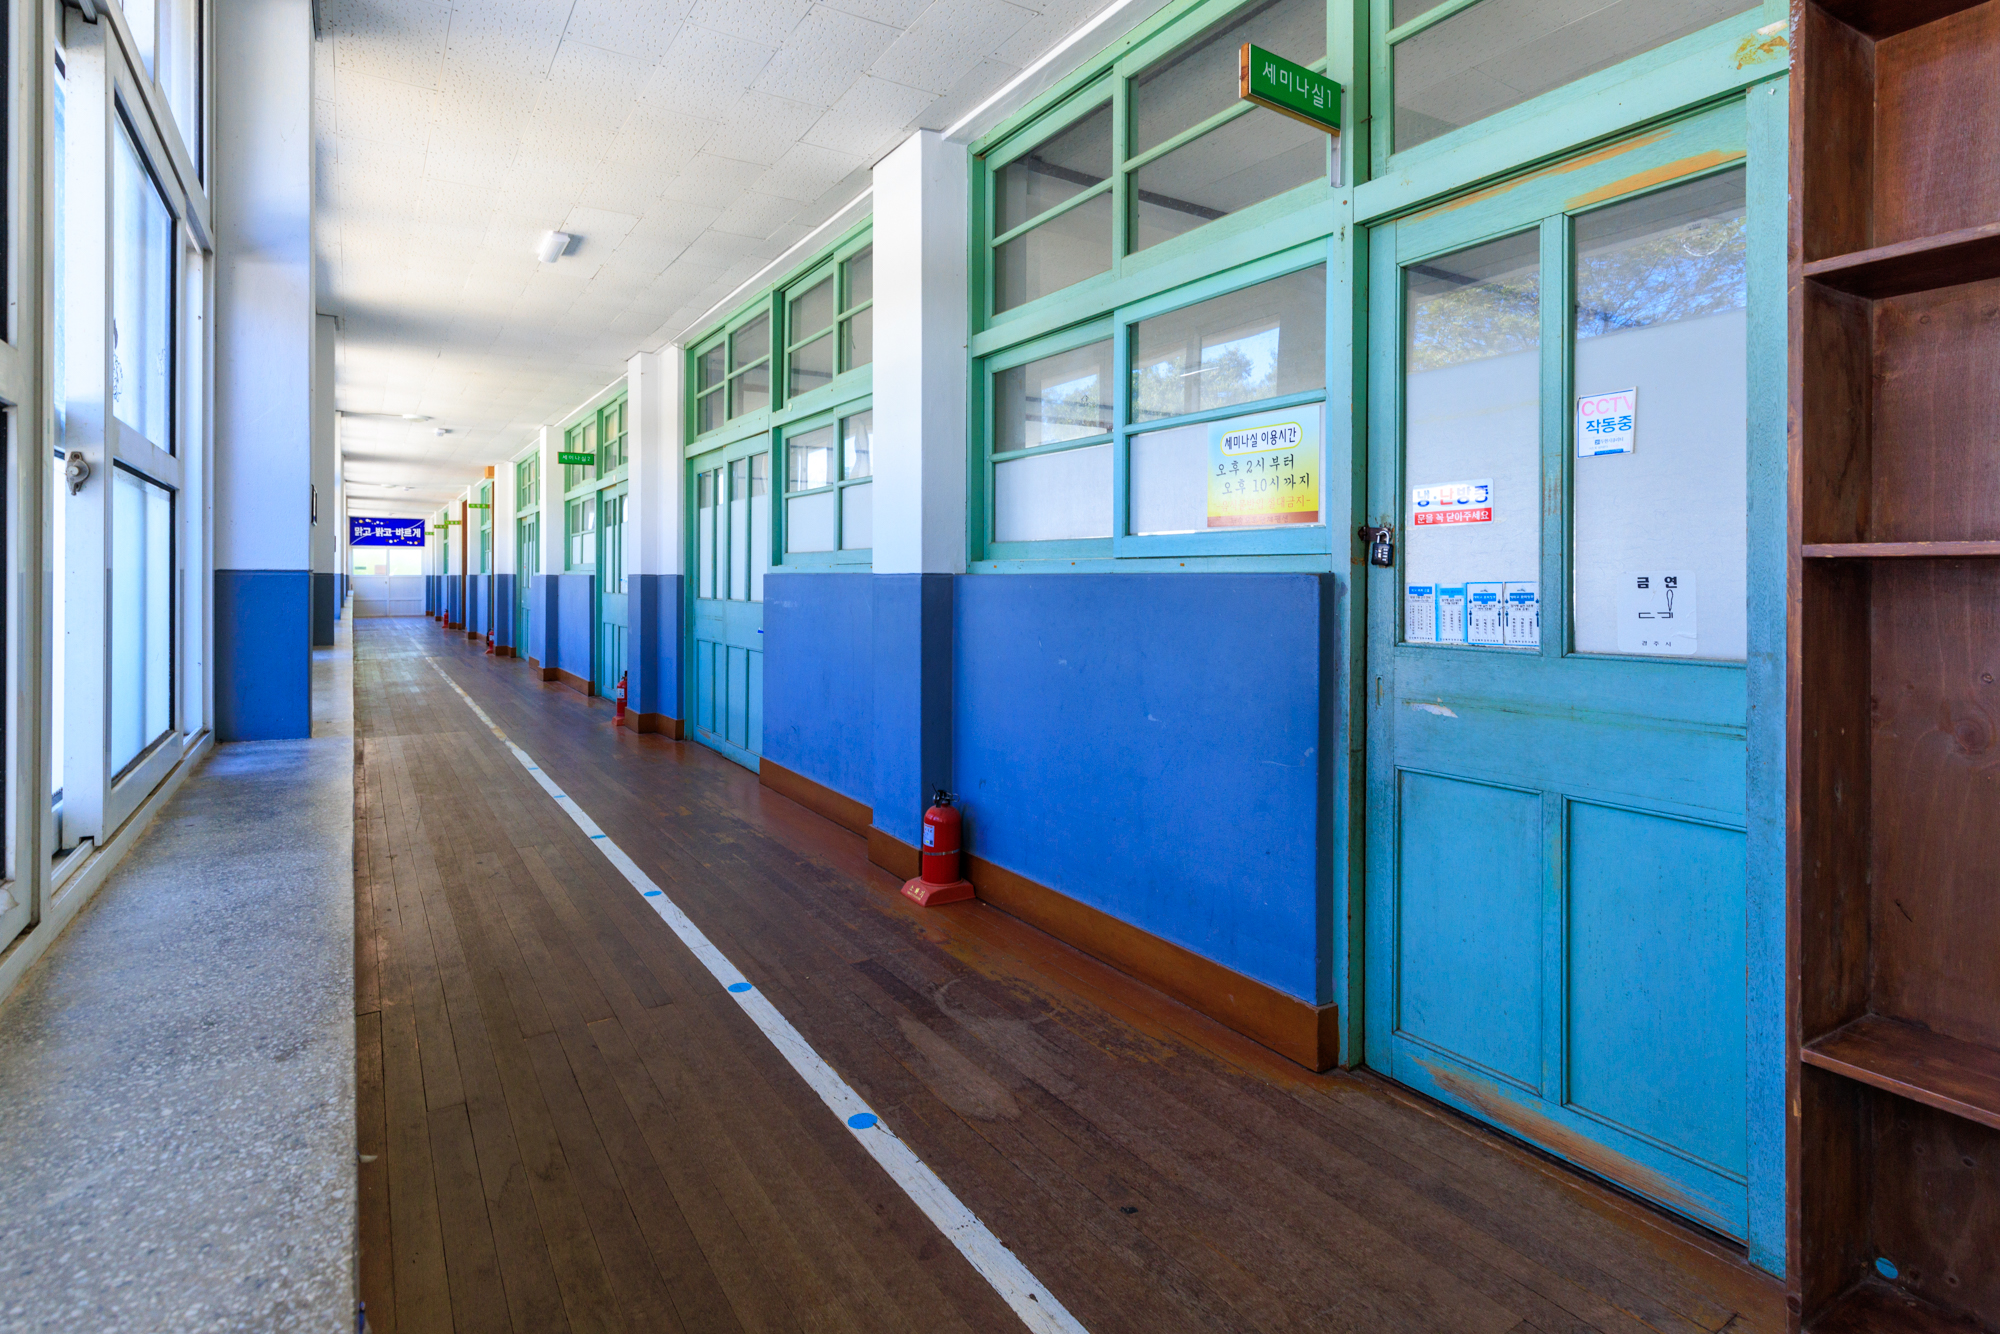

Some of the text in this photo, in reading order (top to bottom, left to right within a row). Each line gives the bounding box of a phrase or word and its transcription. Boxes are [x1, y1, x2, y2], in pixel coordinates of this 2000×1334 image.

[1262, 61, 1331, 108] 세미나실1
[1581, 395, 1633, 417] CCTV
[1585, 415, 1632, 434] 작동중
[1224, 427, 1297, 450] 세미나실 이용시간
[1216, 460, 1239, 476] 오후
[1222, 479, 1246, 495] 오후
[1417, 510, 1490, 524] 문을 꼭 닫아주세요
[354, 527, 421, 538] 맑고 밝고 바르게
